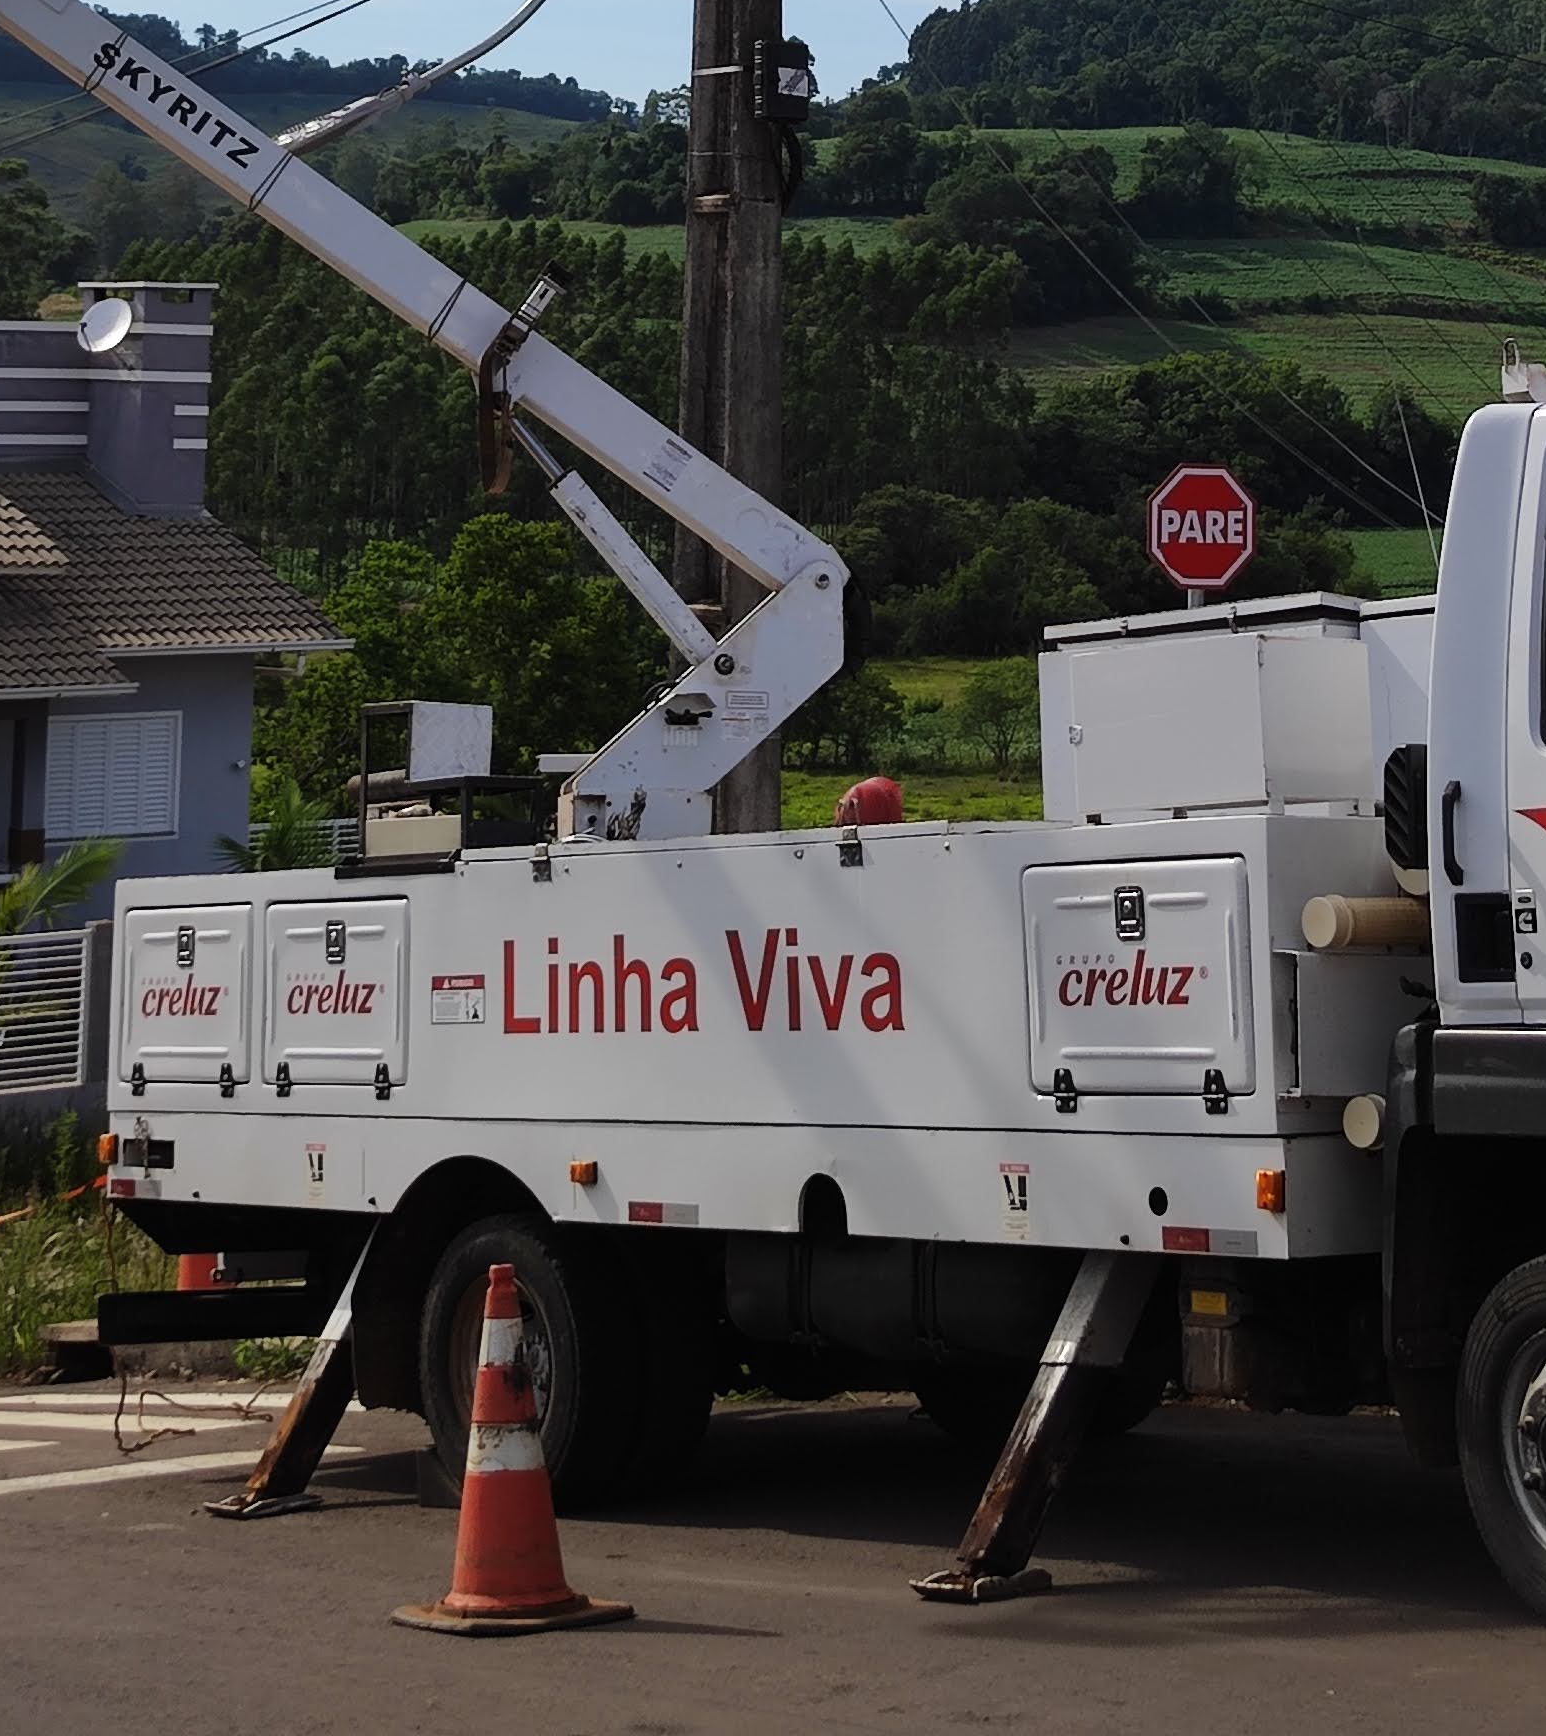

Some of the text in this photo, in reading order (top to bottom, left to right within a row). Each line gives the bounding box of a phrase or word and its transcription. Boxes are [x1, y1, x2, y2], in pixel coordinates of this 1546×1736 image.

[94, 43, 260, 169] SKYRITZ
[1160, 509, 1243, 544] PARE
[503, 928, 905, 1033] Linha Viva
[1056, 954, 1115, 964] GRUPO
[1058, 949, 1194, 1006] creluz
[142, 973, 221, 1017] creluz
[287, 969, 376, 1014] creluz
